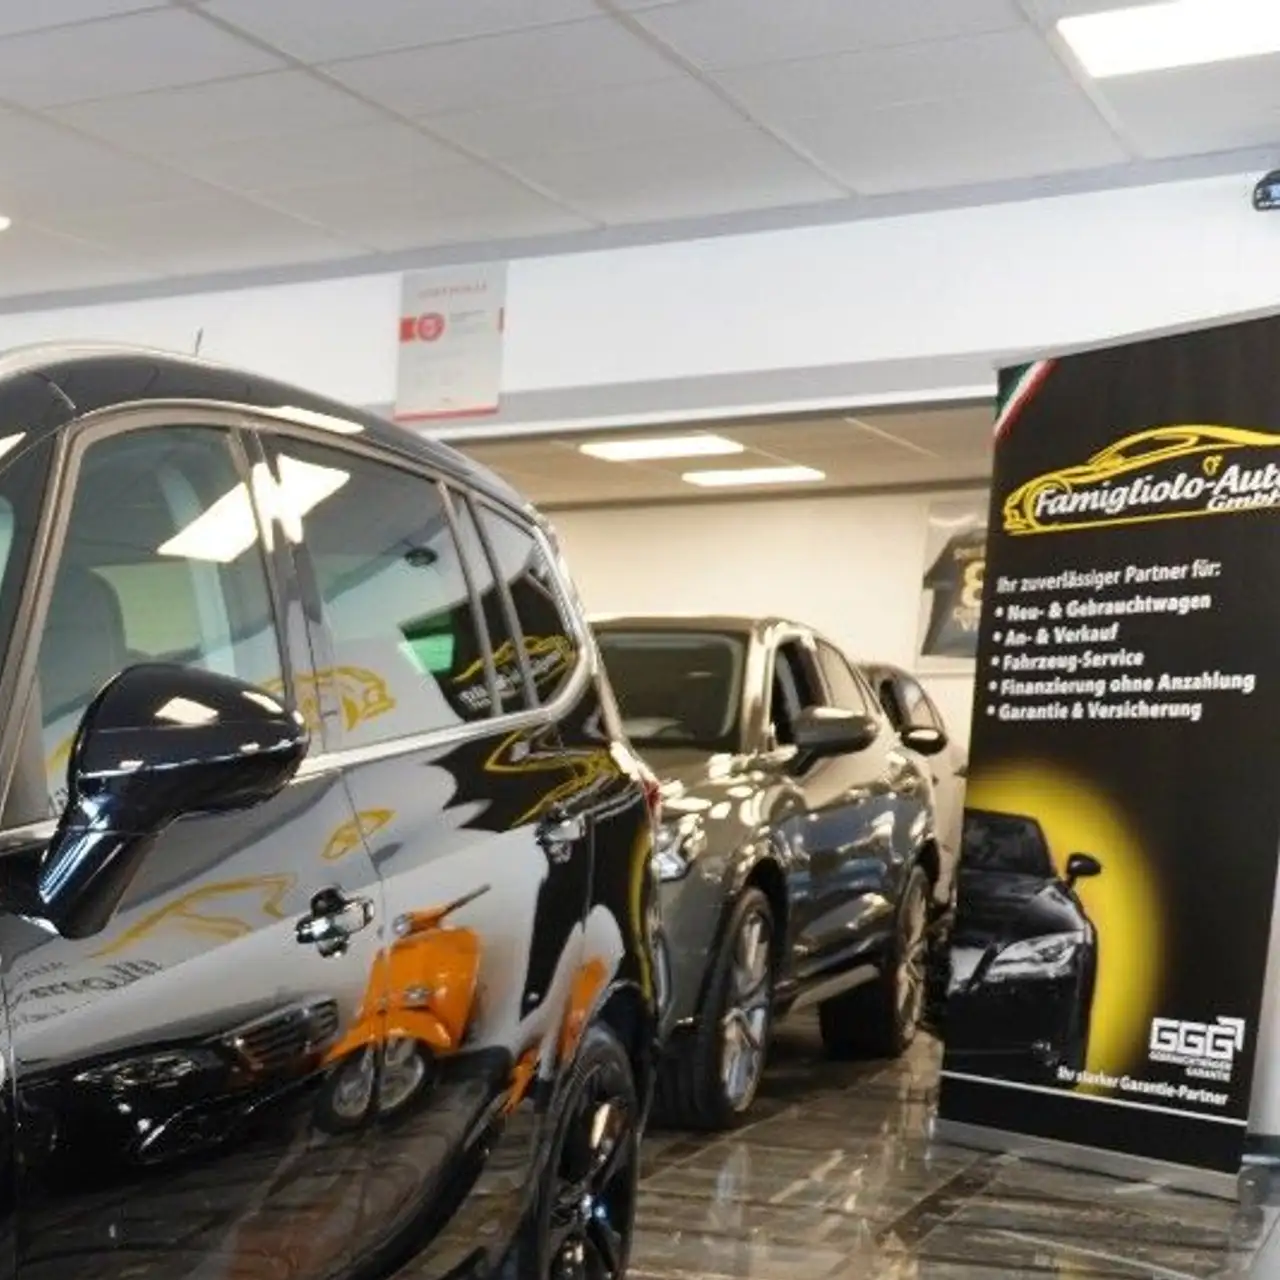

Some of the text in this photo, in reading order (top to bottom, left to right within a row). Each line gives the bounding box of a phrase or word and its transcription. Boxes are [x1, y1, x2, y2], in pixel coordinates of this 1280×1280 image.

[996, 558, 1221, 593] Ihr zuverlässiger Partner für:
[1006, 604, 1044, 622] Neu-
[1048, 601, 1062, 620] &
[1065, 594, 1212, 618] Gebrauchtwagen
[1003, 622, 1120, 647] An- & Verkauf
[1002, 648, 1144, 673] Fahrzeug-Service
[1000, 670, 1256, 698] Finanzierung ohne Anzahlung
[998, 700, 1203, 722] Garantie & Versicherung
[1150, 1017, 1236, 1060] GGG
[1120, 1075, 1228, 1105] Garantie-Partner
